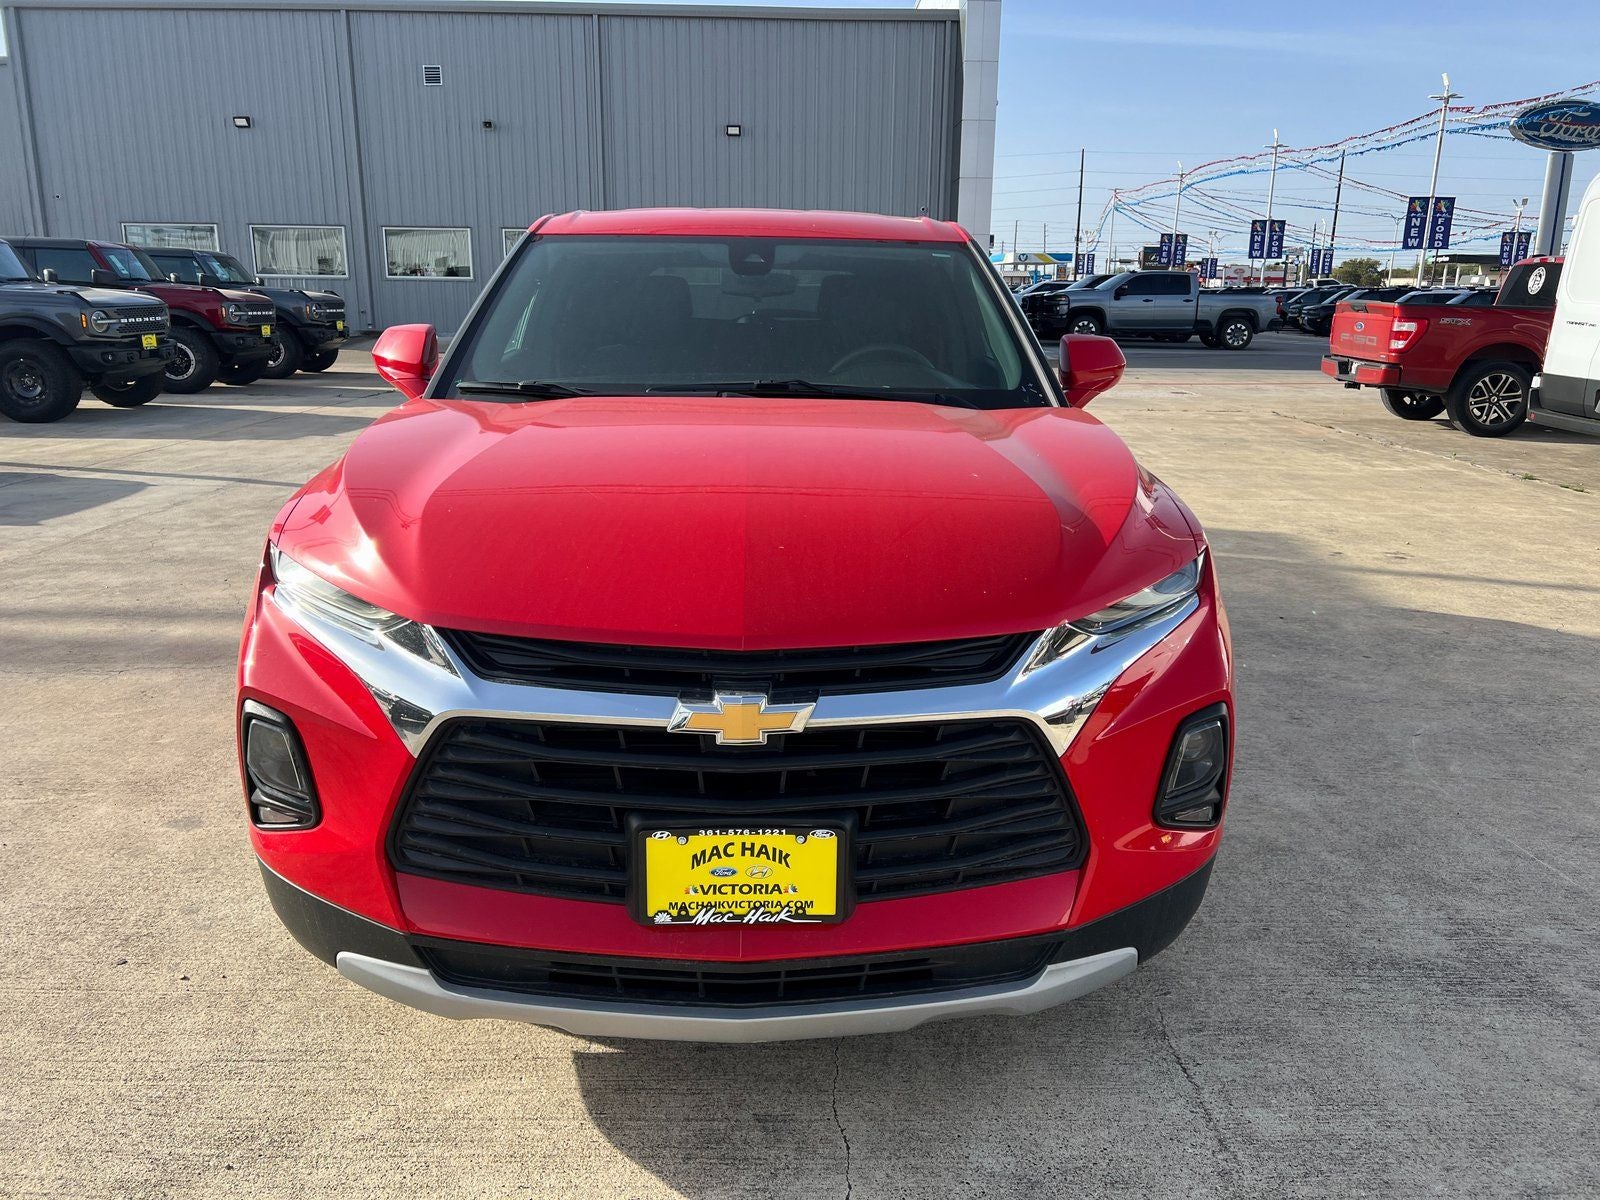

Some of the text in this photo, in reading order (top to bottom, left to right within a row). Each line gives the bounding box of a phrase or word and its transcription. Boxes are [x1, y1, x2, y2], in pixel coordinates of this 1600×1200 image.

[1407, 218, 1421, 247] NEW
[1434, 218, 1446, 248] FORD
[1161, 246, 1169, 264] NEW
[1252, 235, 1262, 258] NEW
[1271, 235, 1279, 258] FORD
[1501, 245, 1511, 265] NEW
[691, 841, 792, 870] MAC HAIK
[712, 867, 736, 877] Ford
[700, 883, 783, 896] VICTORIA
[691, 907, 796, 925] Mac Haik
